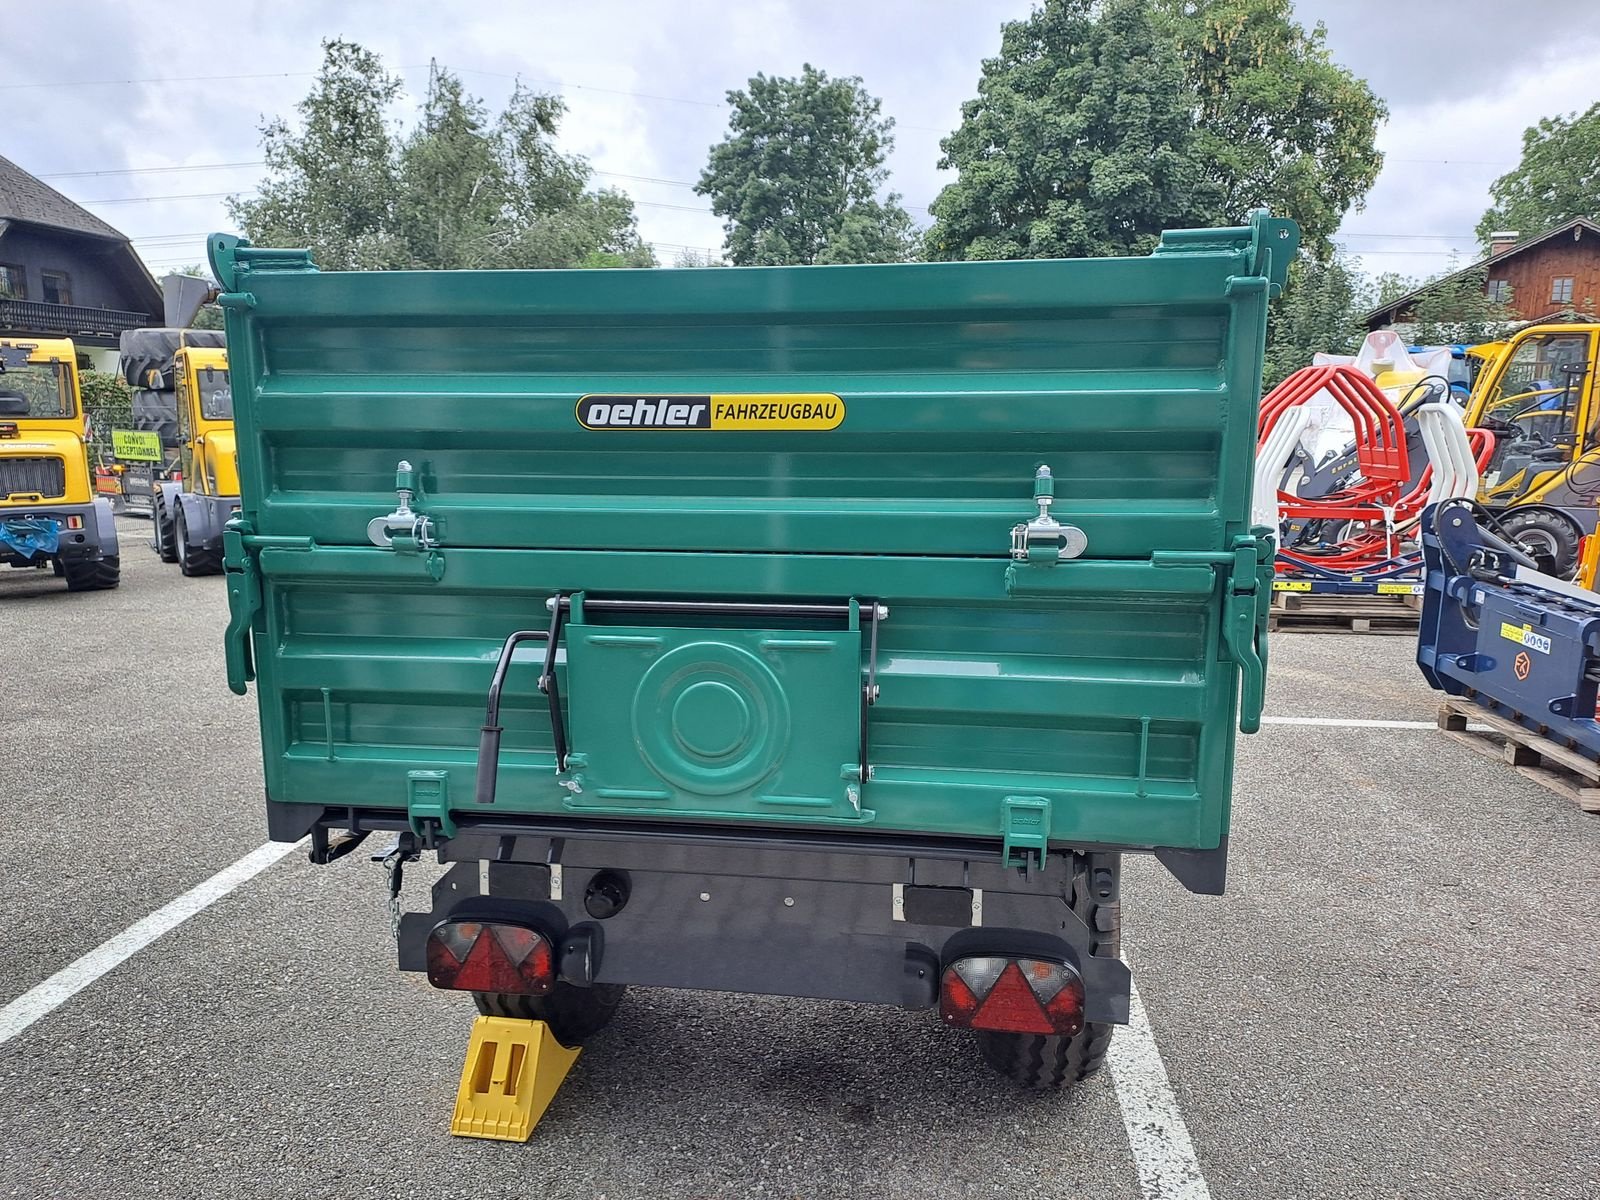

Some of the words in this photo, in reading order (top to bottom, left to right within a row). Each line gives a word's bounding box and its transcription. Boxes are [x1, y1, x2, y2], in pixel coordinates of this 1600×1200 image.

[587, 399, 706, 426] oehler
[715, 403, 837, 420] FAHRZEUGBAU
[123, 435, 146, 445] CONVOI
[116, 445, 158, 457] EXCEPTIONNEL
